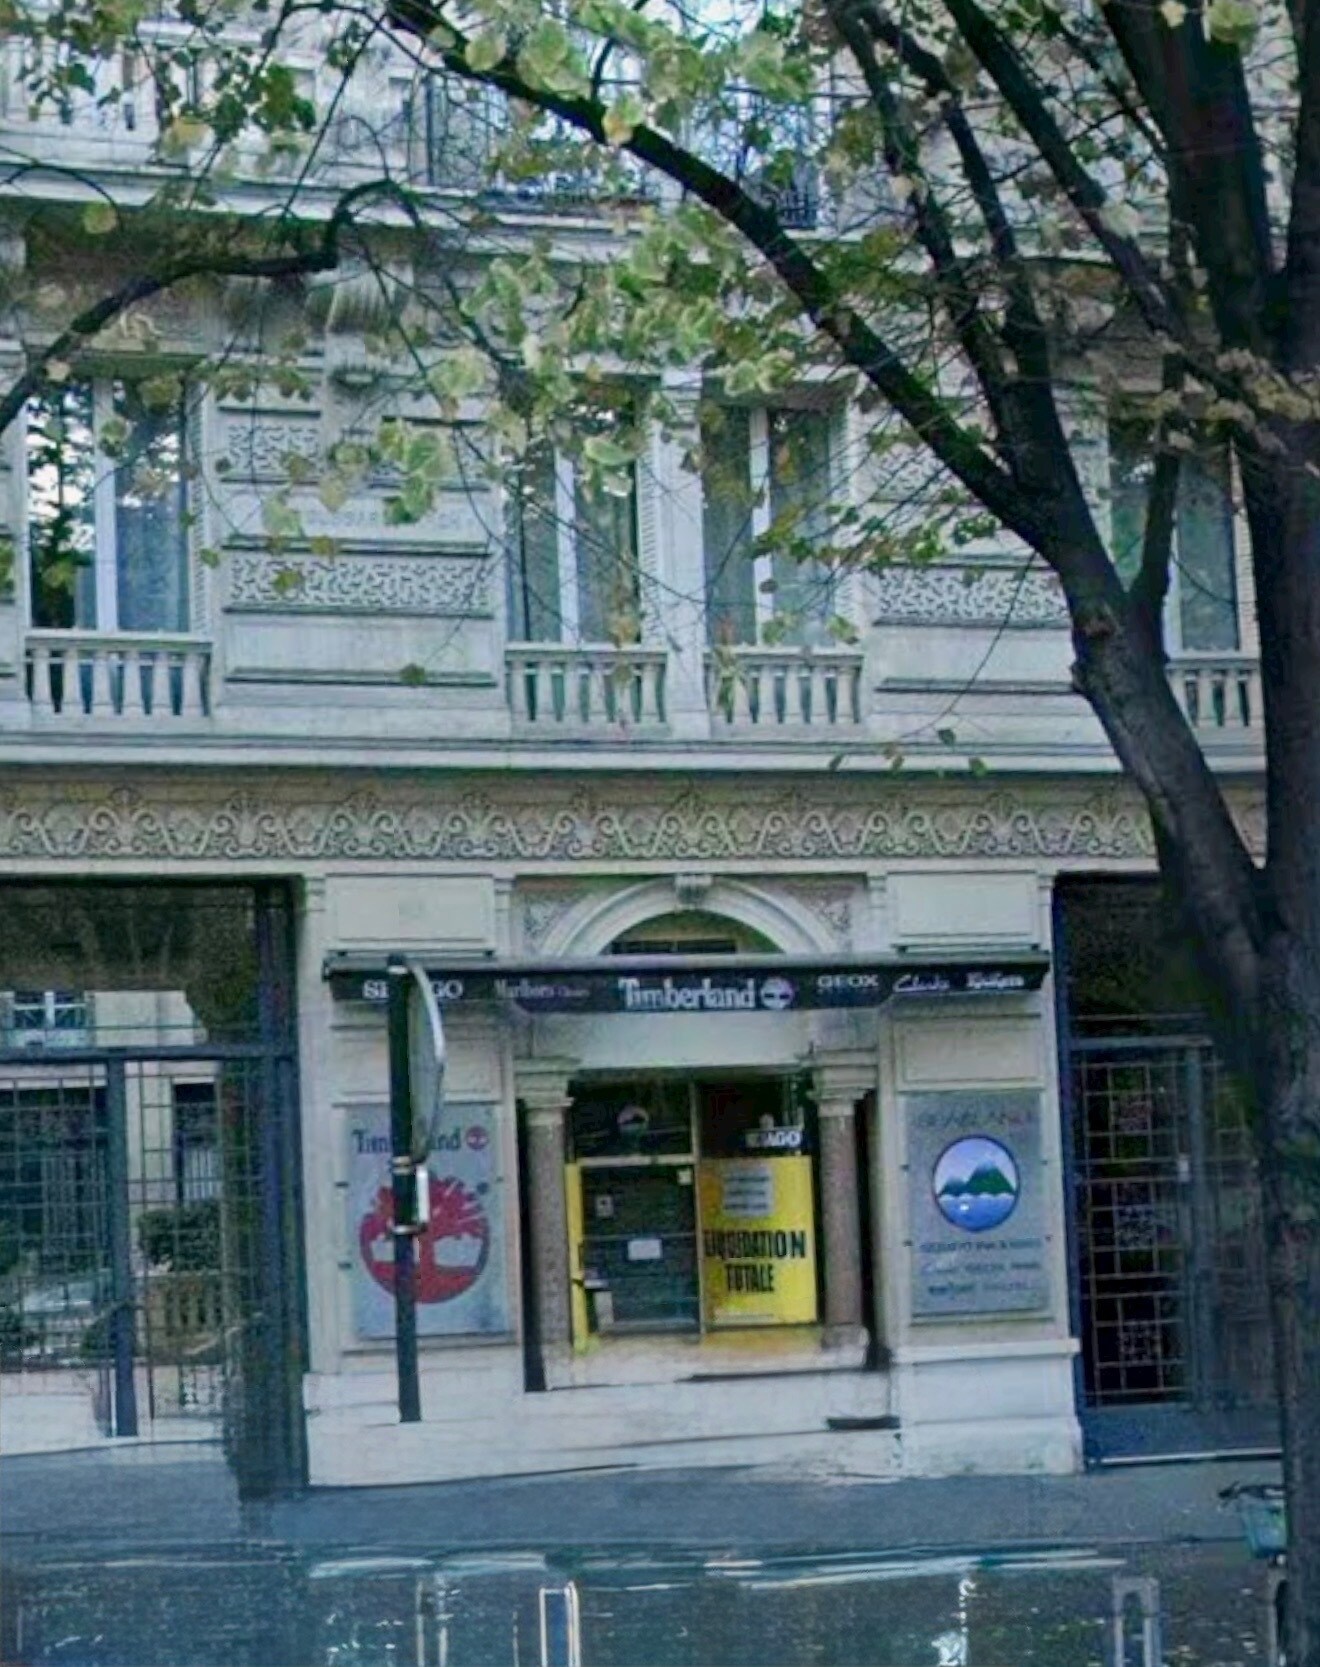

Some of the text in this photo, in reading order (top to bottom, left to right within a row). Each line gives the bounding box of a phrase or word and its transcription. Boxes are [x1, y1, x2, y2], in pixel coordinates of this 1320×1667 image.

[618, 977, 756, 1009] Timberland
[817, 973, 879, 988] GEOX
[725, 1263, 775, 1293] TOTALE
